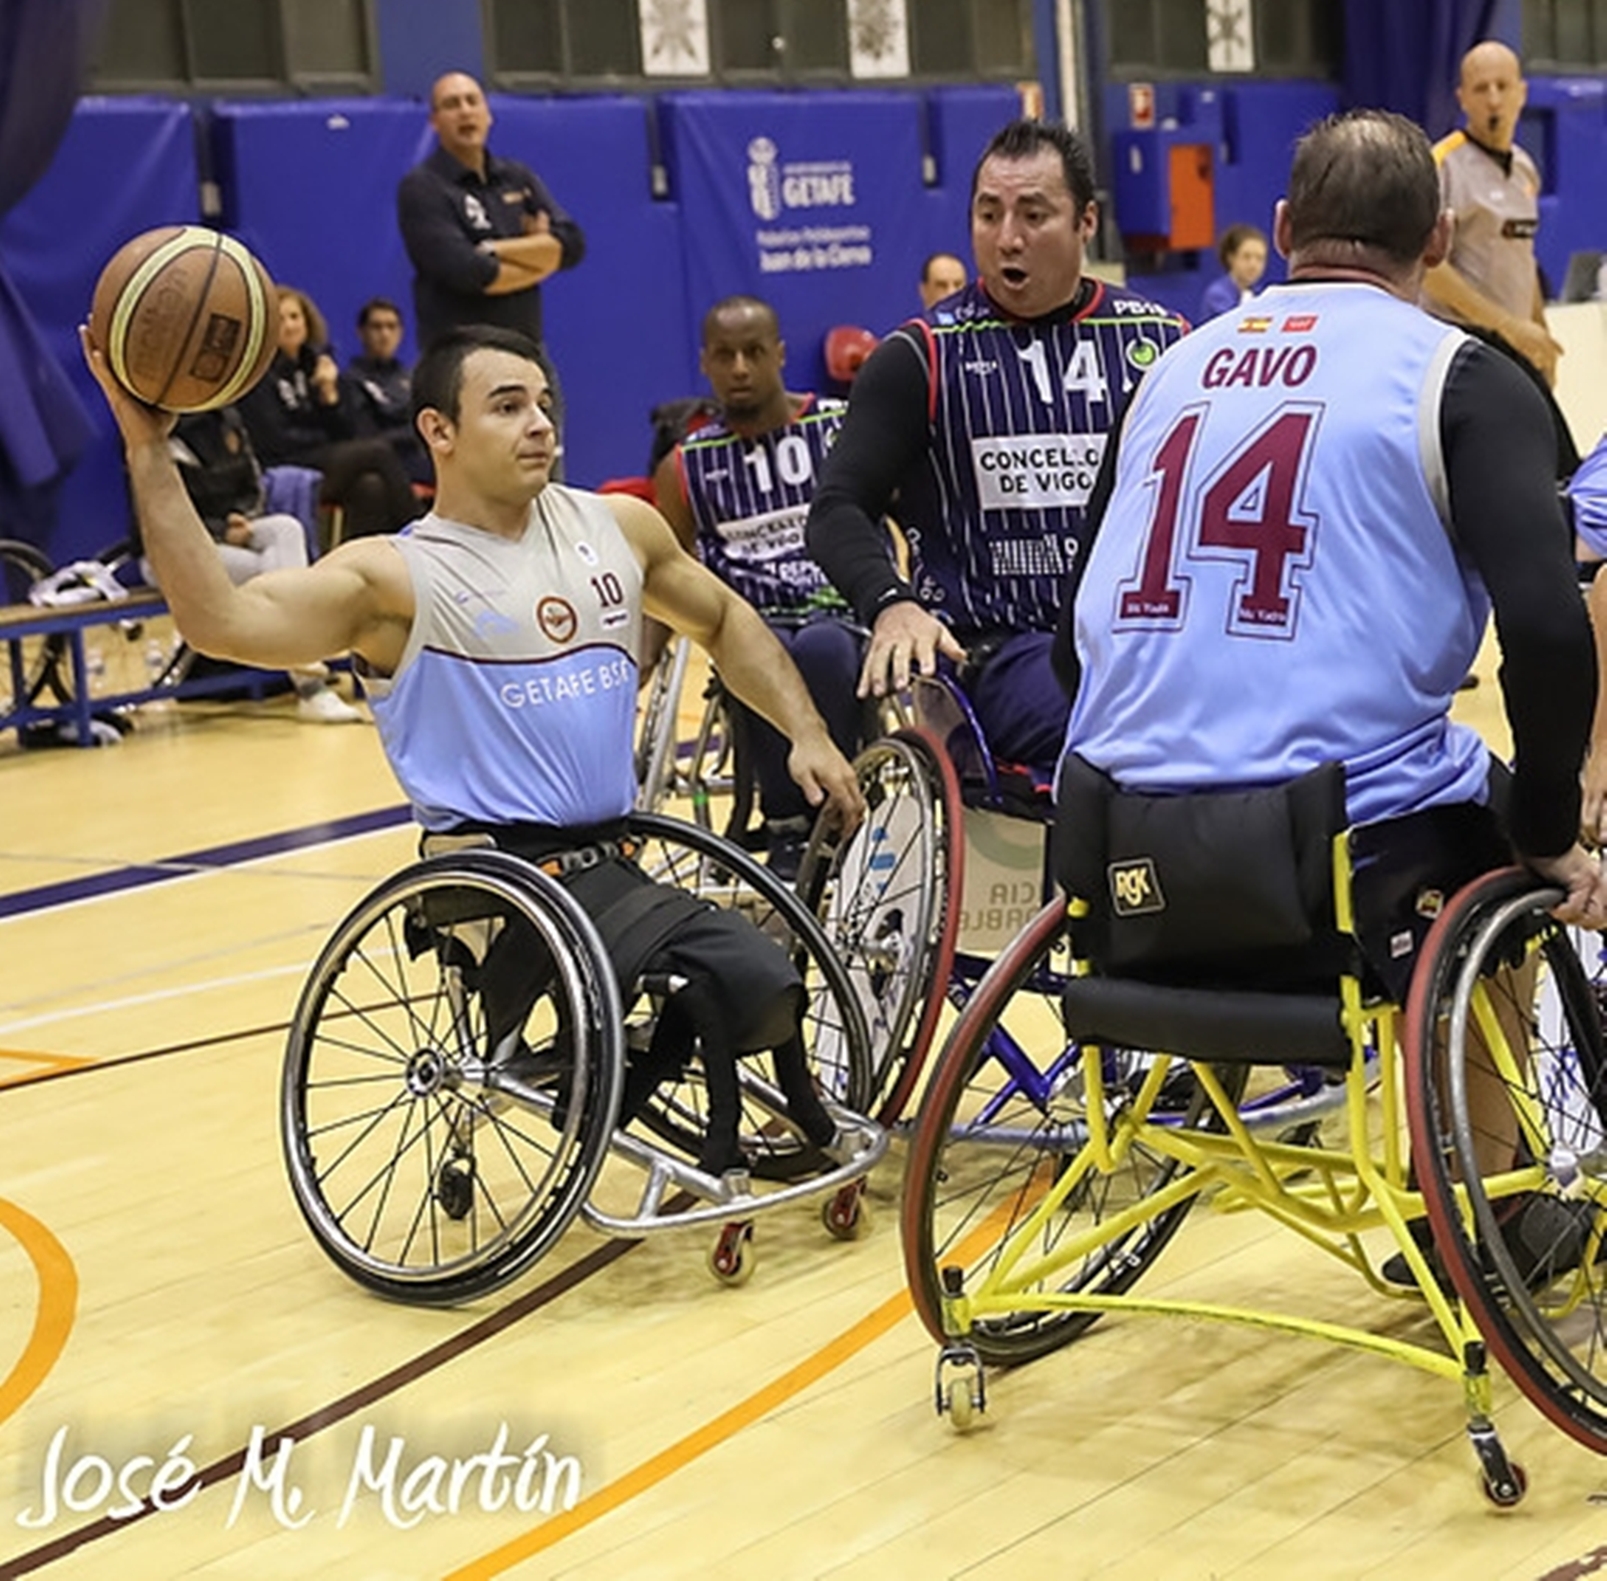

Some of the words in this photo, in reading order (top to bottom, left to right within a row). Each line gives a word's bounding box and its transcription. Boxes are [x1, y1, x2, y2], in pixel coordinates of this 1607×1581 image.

[783, 174, 855, 207] GETAFE
[1016, 339, 1107, 404] 14
[1201, 345, 1318, 389] GAVO
[744, 435, 811, 492] 10
[1000, 474, 1029, 493] DE
[1035, 471, 1093, 491] VIGO
[1112, 400, 1326, 641] 14
[591, 571, 625, 609] 10
[501, 668, 597, 708] GETAFE
